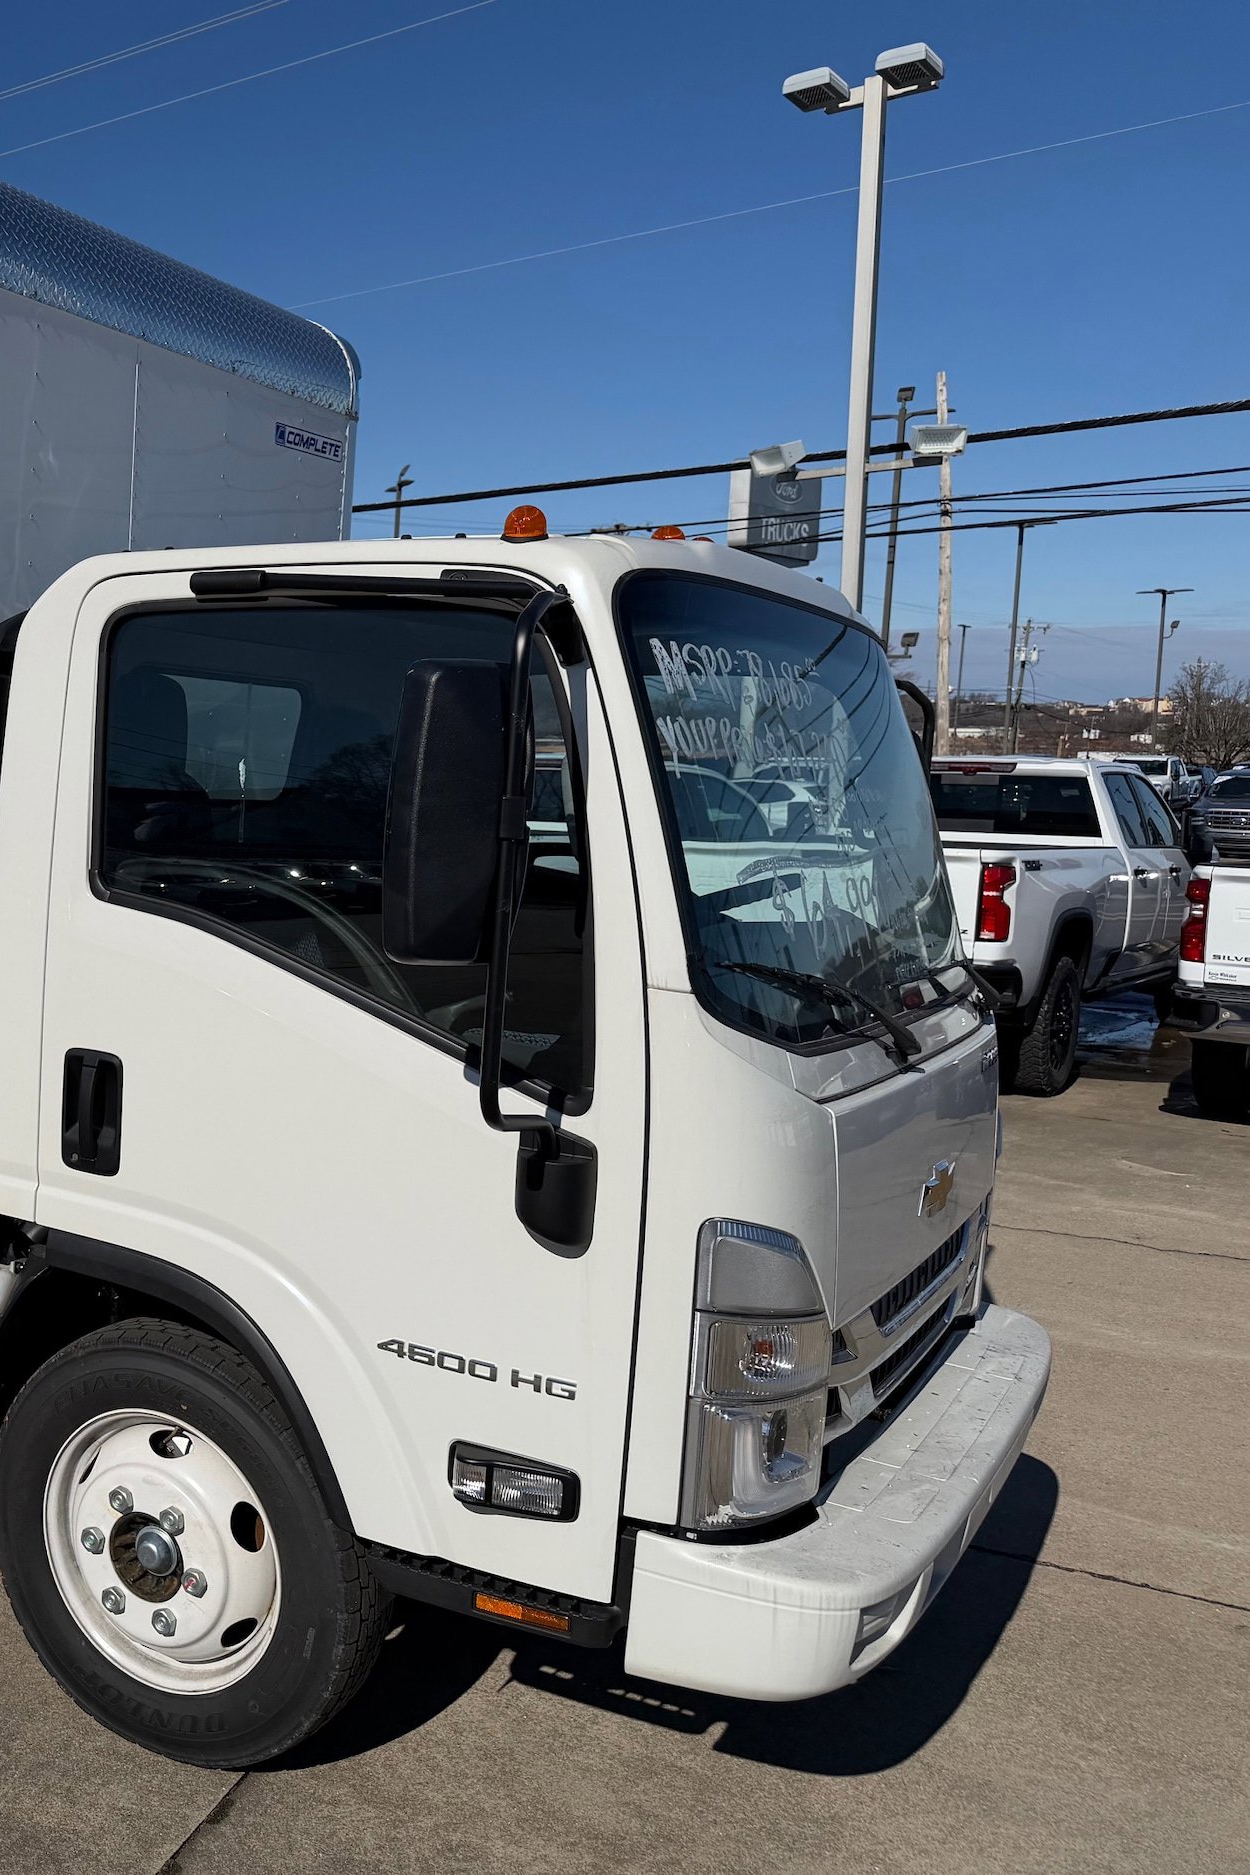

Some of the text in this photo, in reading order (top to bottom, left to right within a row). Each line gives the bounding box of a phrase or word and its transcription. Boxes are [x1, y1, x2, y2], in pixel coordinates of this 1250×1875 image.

[286, 430, 342, 458] COMPLETE
[761, 516, 810, 547] TRUCKS
[376, 1338, 578, 1401] 4500 HG
